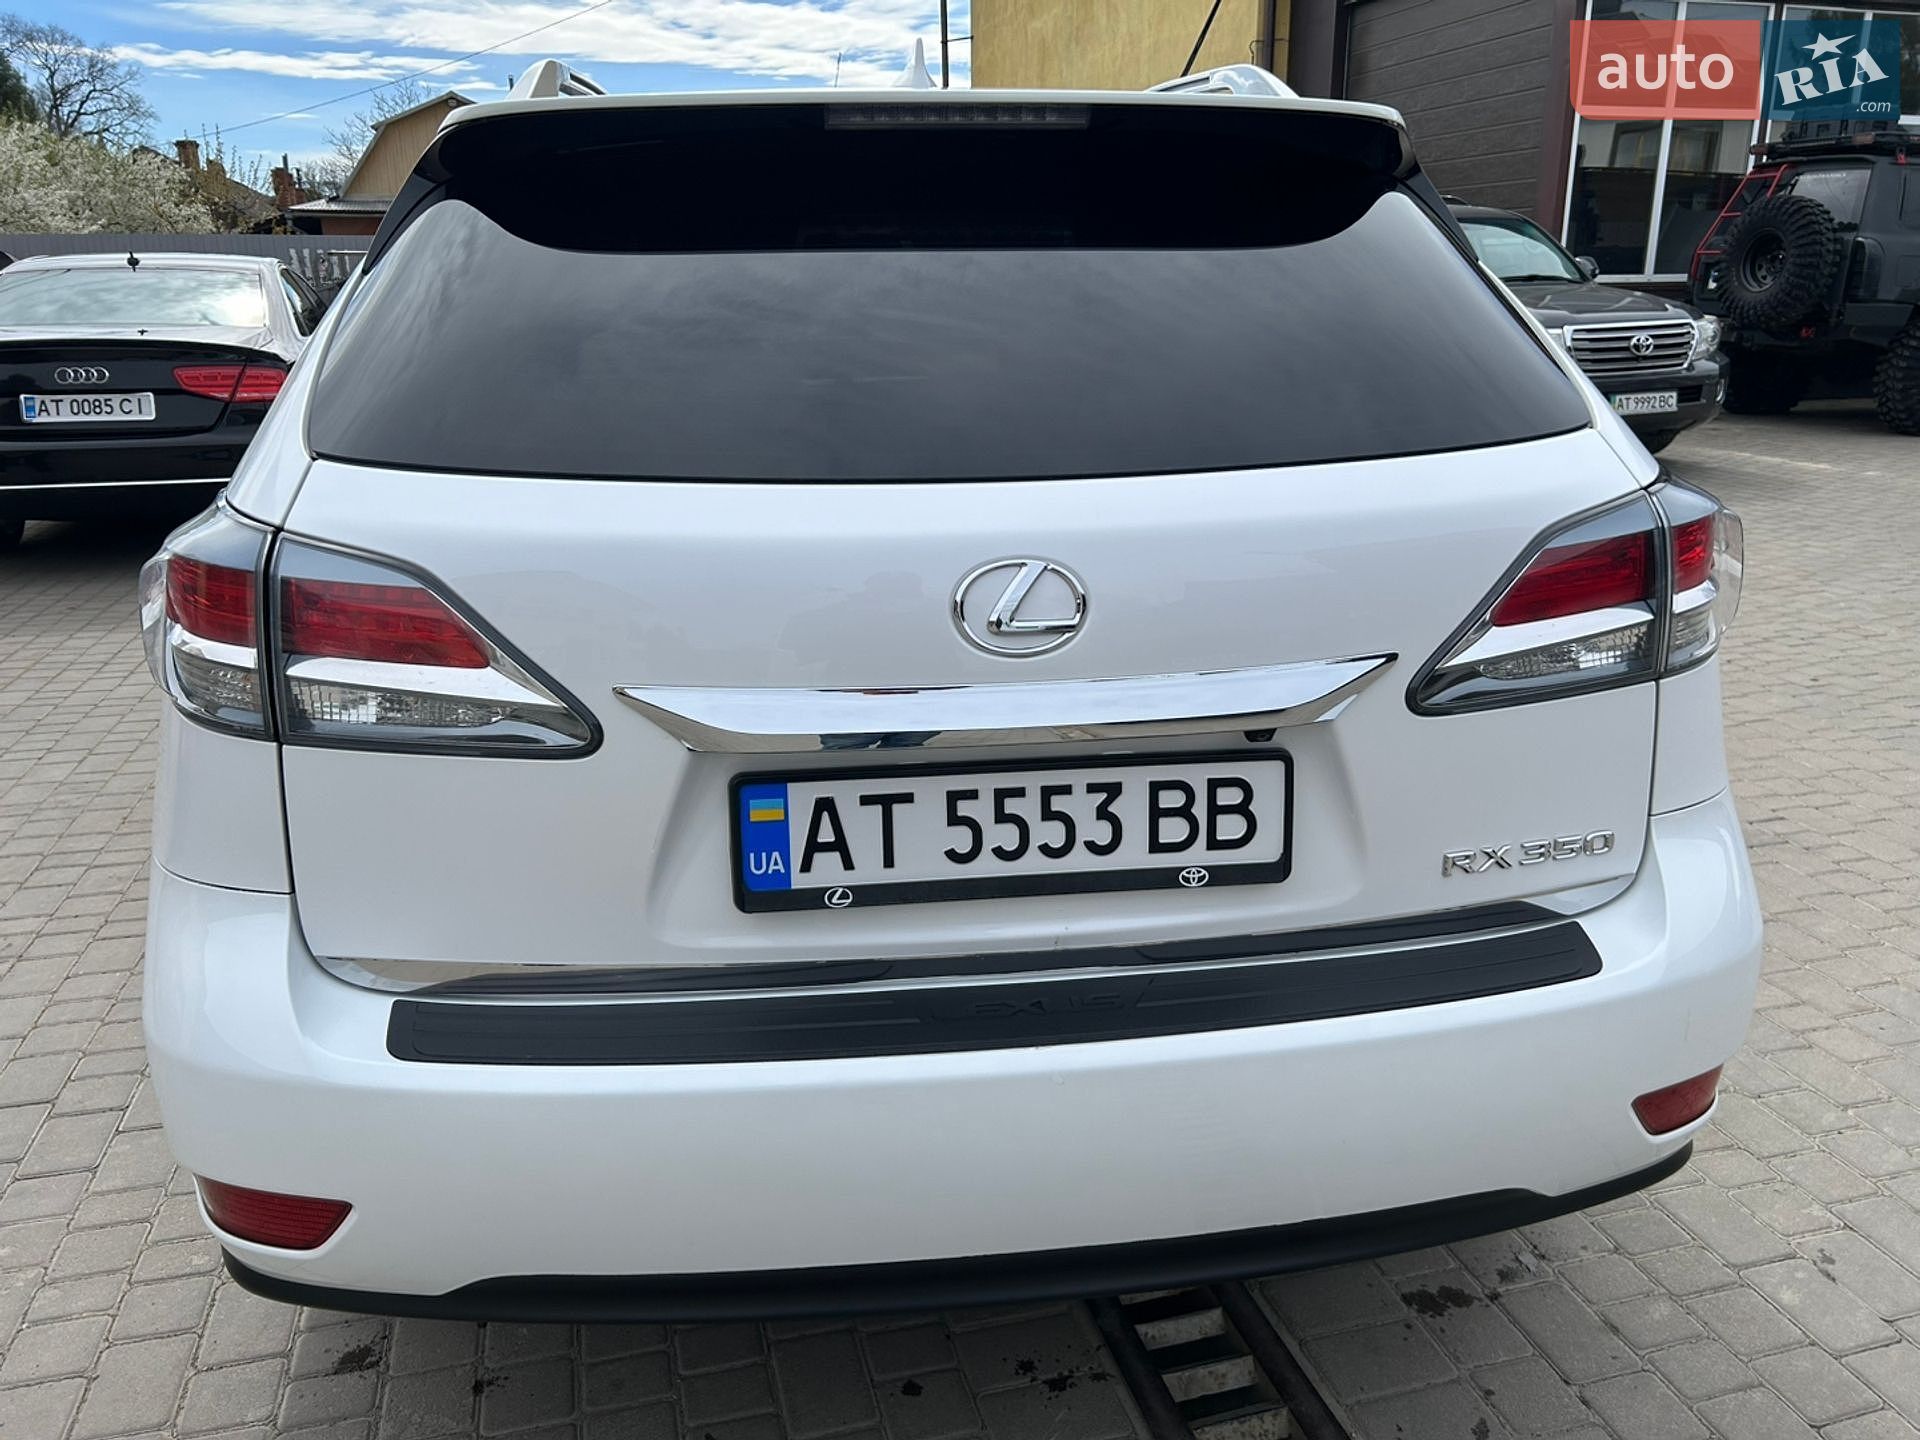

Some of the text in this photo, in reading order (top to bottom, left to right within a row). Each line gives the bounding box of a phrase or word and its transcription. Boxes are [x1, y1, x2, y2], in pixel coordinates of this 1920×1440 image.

[38, 398, 143, 416] AT 0085 CI
[1617, 397, 1632, 410] AT
[799, 776, 1258, 874] AT 5553 BB
[749, 851, 786, 875] UA
[1441, 829, 1616, 877] RX 350
